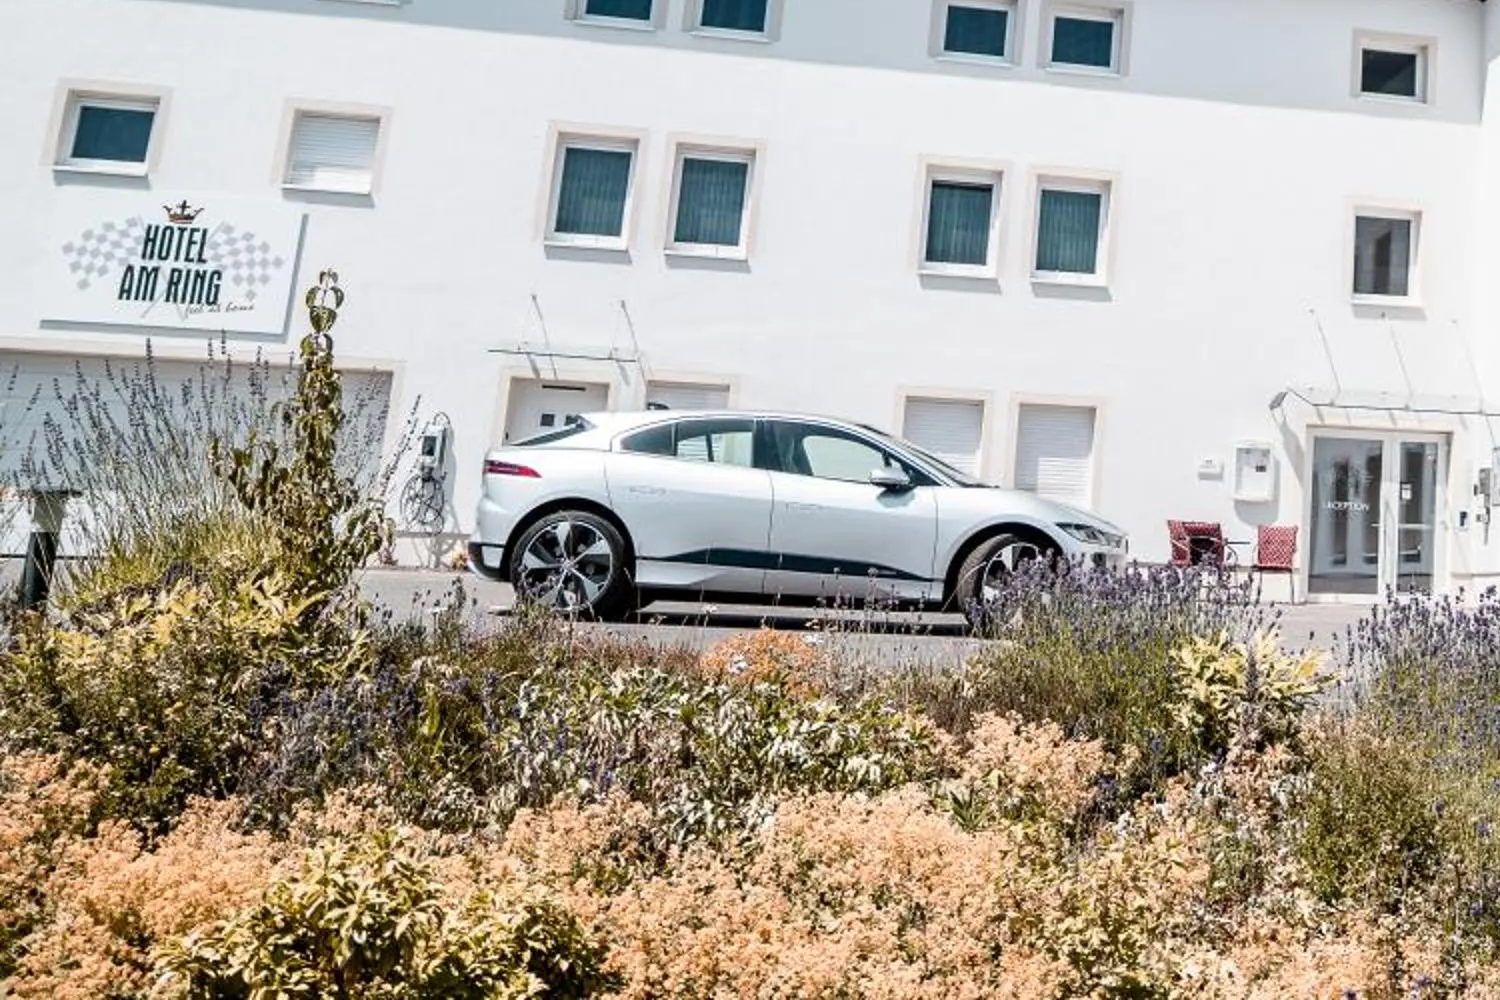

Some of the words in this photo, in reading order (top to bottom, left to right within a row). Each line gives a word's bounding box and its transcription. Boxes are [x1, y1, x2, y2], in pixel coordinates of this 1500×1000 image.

[141, 224, 208, 263] HOTEL
[118, 264, 160, 301] AM
[165, 267, 222, 306] RING
